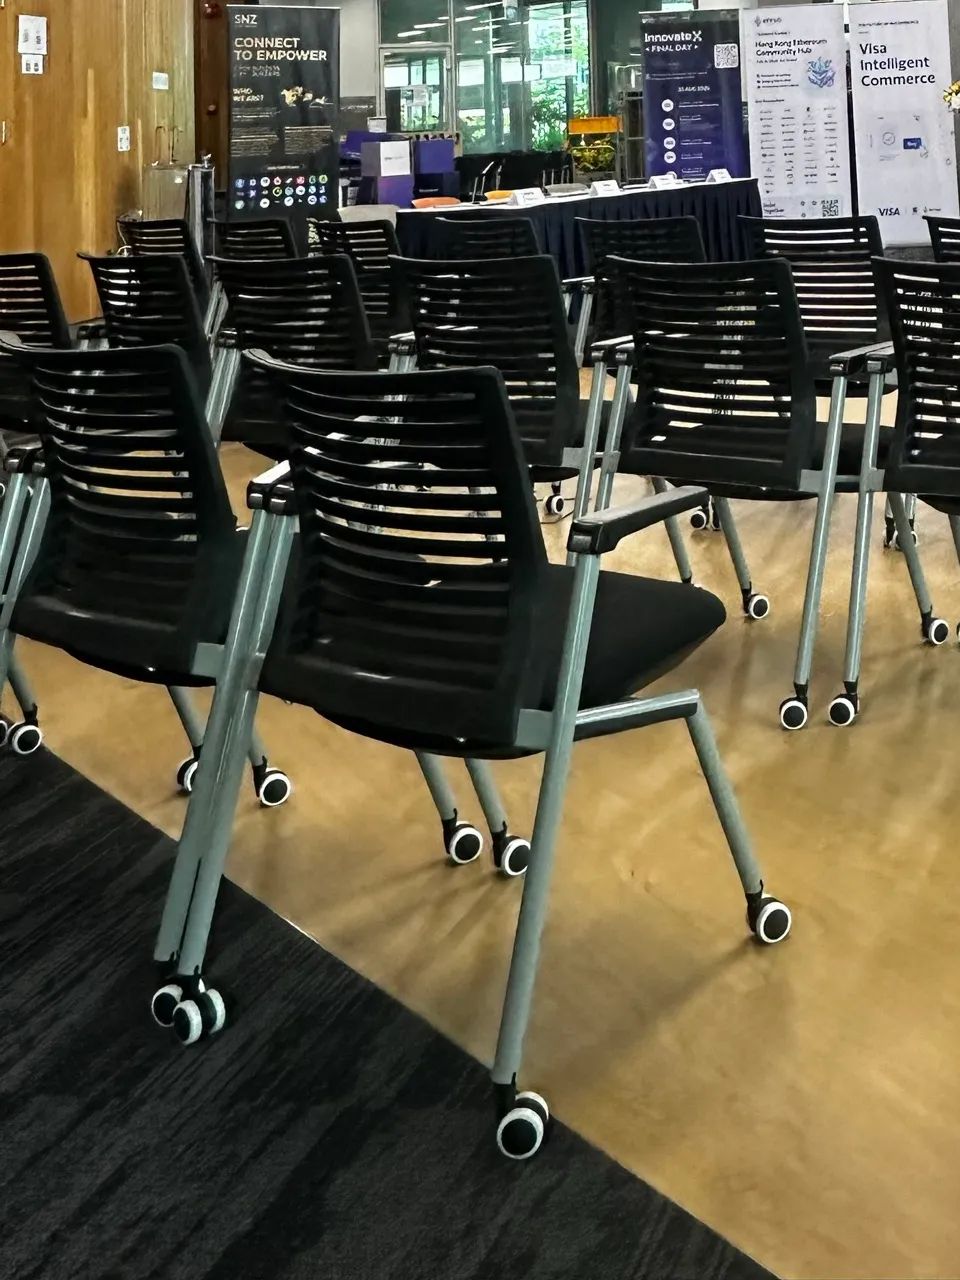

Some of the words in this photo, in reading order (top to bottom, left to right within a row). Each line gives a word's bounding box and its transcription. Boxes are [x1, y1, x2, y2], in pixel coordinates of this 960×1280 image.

[234, 14, 258, 24] SNZ
[234, 37, 300, 48] CONNECT
[860, 43, 887, 54] Visa
[233, 50, 252, 60] TO
[256, 50, 327, 61] EMPOWER
[861, 57, 930, 71] Intelligent
[861, 74, 936, 86] Commerce
[878, 208, 900, 216] VISA
